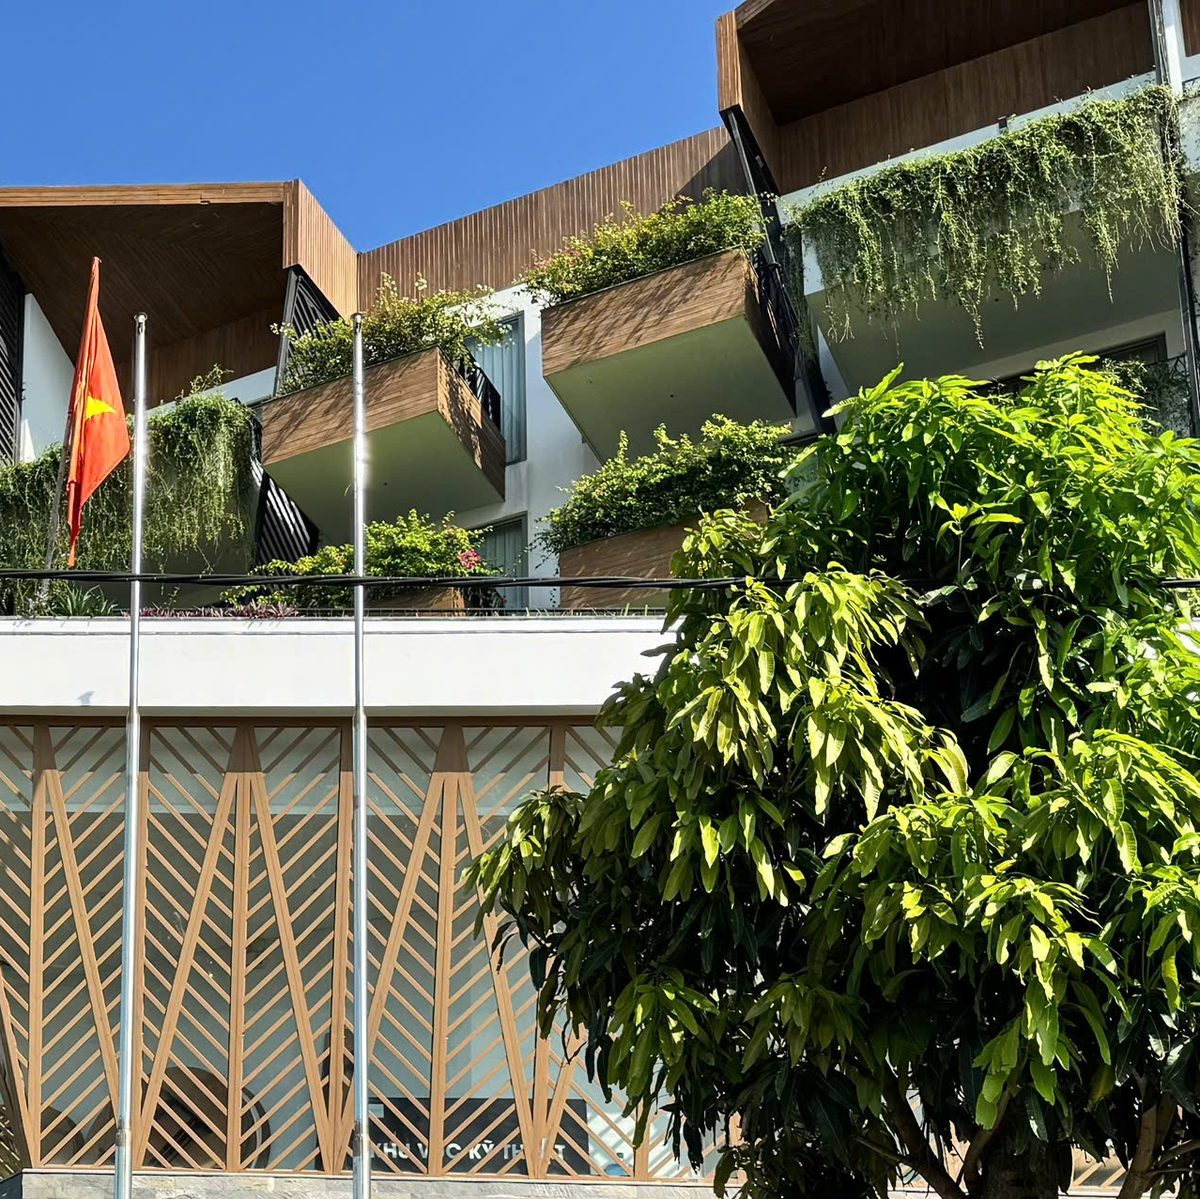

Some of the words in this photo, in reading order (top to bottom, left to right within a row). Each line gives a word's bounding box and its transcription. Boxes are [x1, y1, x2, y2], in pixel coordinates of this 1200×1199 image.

[417, 1142, 462, 1160] VC
[468, 1139, 495, 1160] KỸ
[503, 1143, 566, 1160] THT
